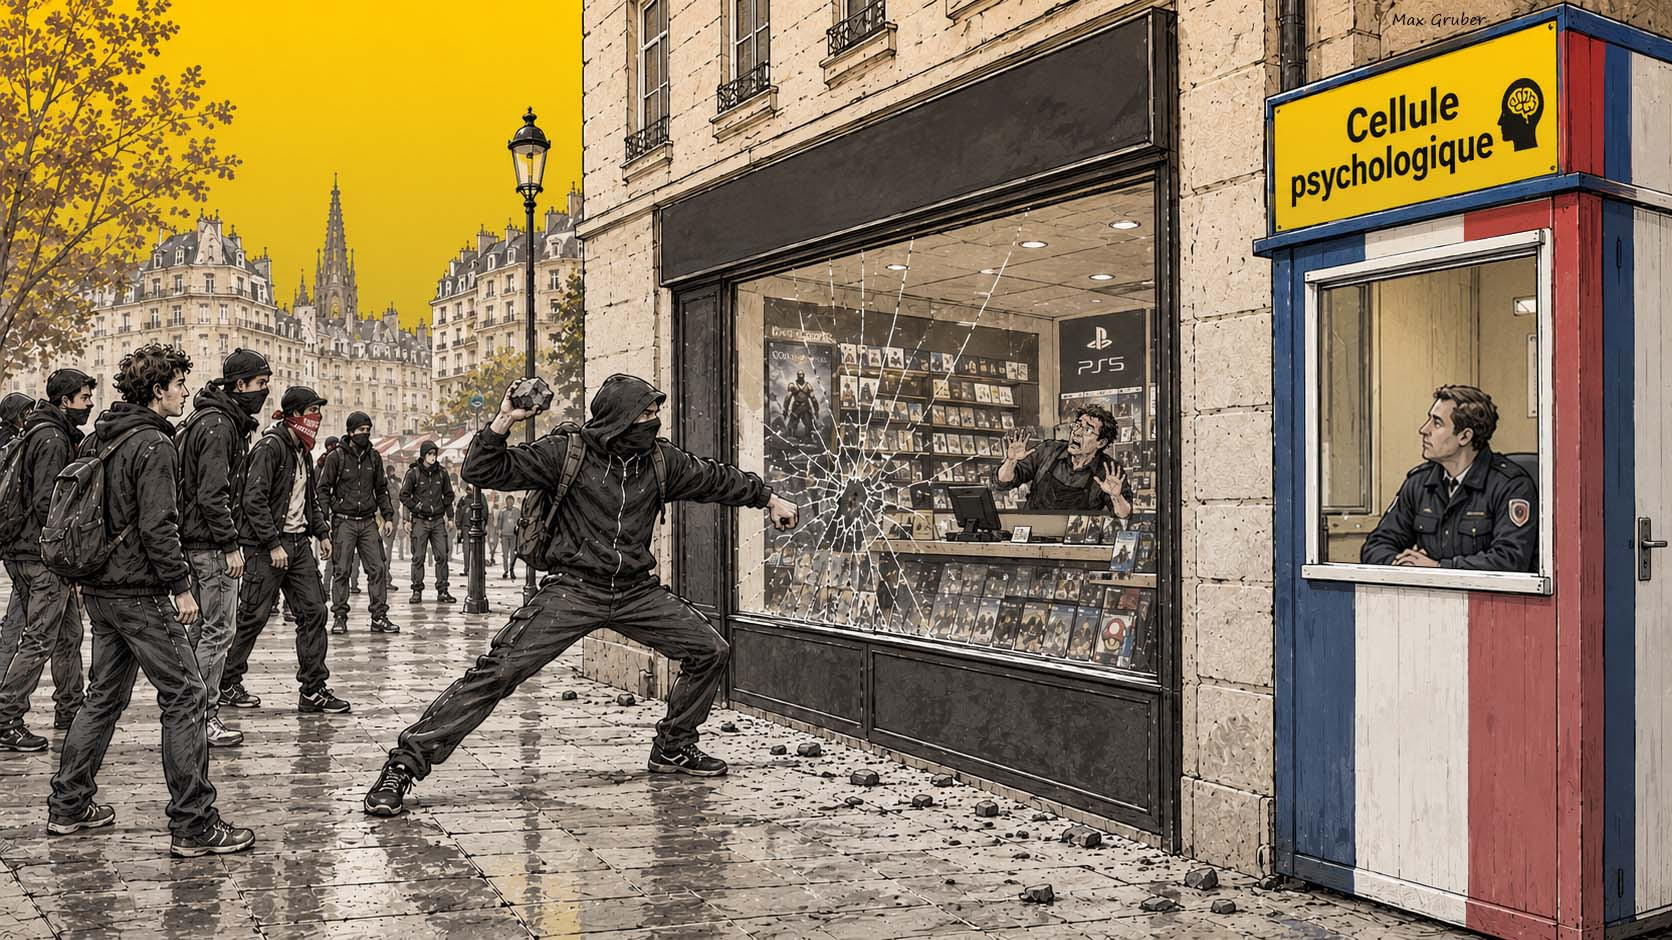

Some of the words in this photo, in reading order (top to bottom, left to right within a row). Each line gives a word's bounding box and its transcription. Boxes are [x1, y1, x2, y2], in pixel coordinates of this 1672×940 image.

[1347, 86, 1459, 143] Cellule
[1291, 132, 1494, 207] psychologique
[1078, 356, 1125, 375] PS5
